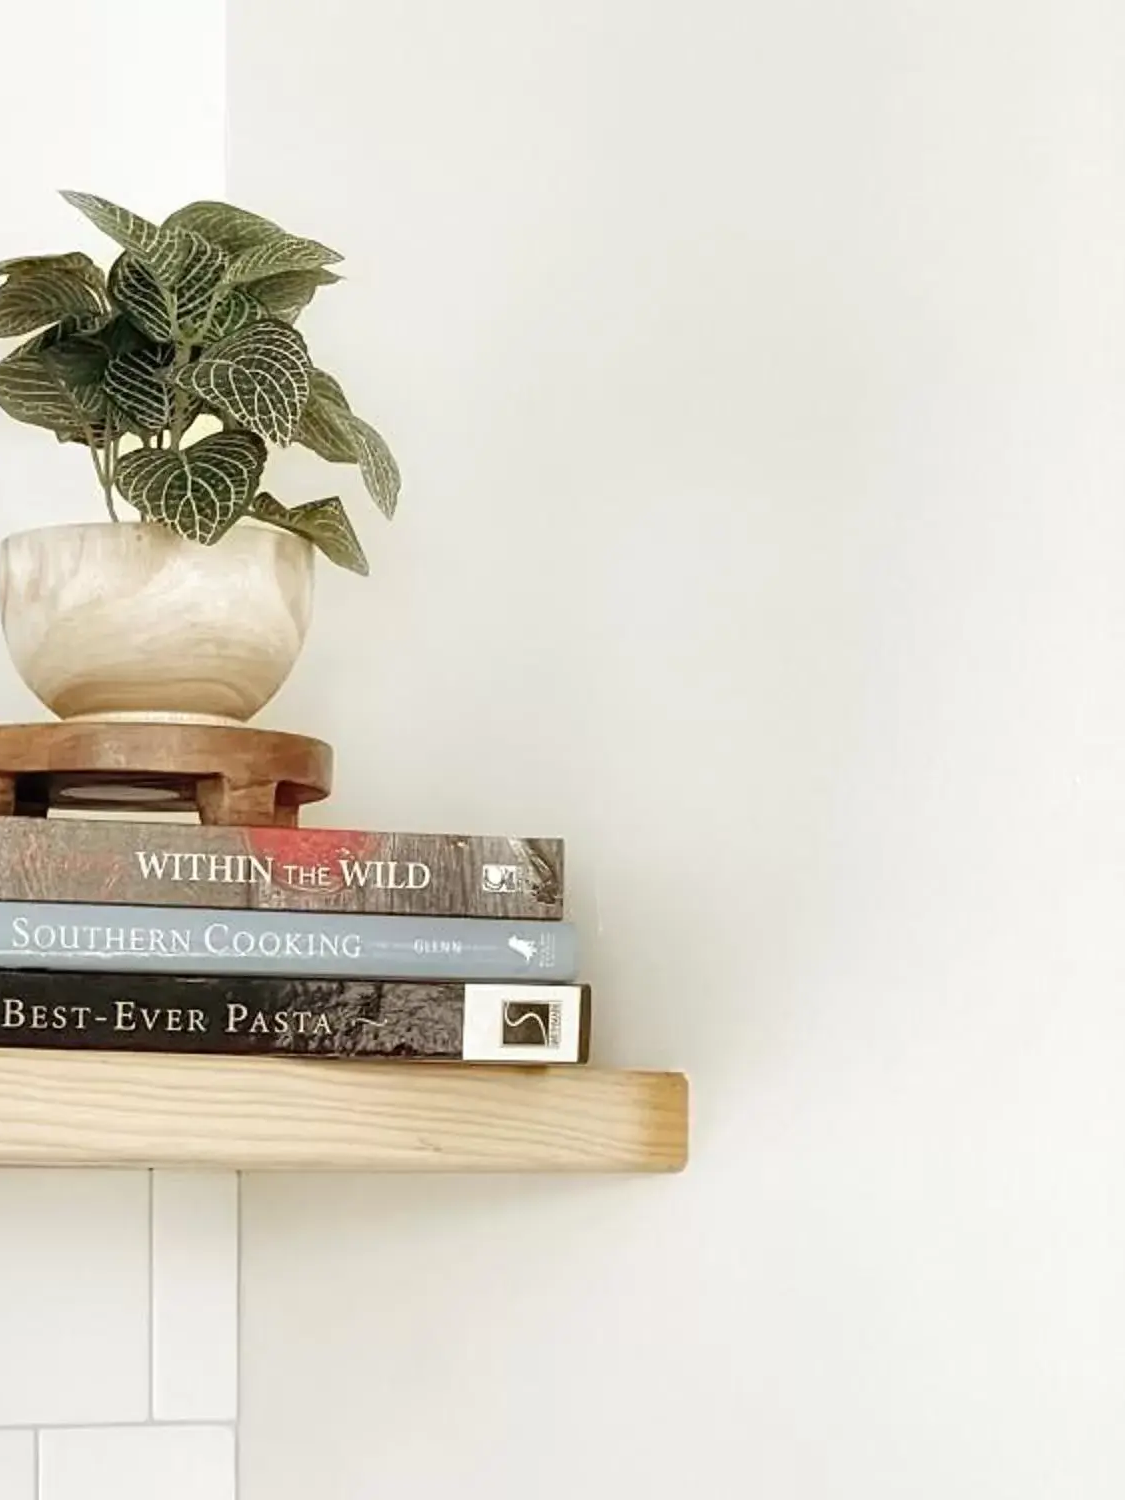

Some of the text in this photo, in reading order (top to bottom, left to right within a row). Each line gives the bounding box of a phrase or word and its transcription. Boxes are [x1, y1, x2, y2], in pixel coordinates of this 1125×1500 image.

[135, 851, 431, 890] WITHIN THE WILD
[11, 917, 191, 952] SOUTHERN
[203, 923, 362, 959] COOKING
[1, 998, 334, 1035] BEST-EVER PASTA
